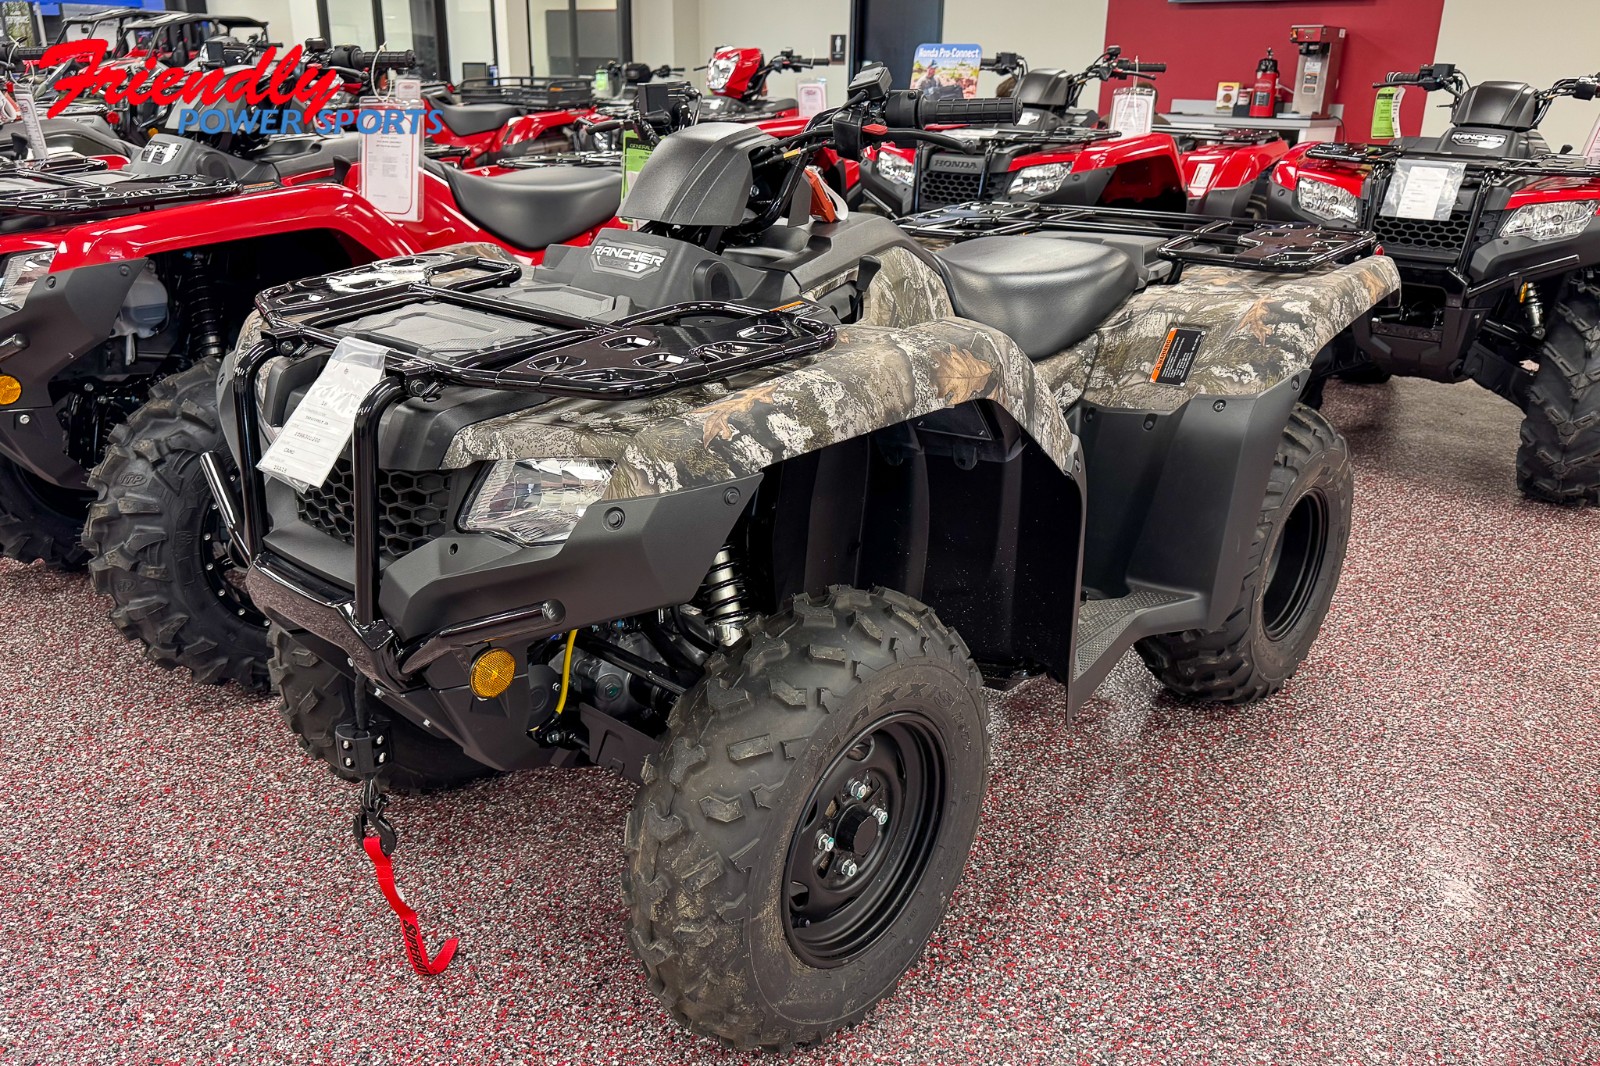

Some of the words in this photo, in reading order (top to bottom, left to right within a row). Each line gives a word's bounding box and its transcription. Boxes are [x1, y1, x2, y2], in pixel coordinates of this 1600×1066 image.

[918, 47, 939, 58] Honda
[939, 47, 980, 58] Pro-Connect
[934, 159, 978, 169] HONDA
[591, 244, 666, 267] RANCHER
